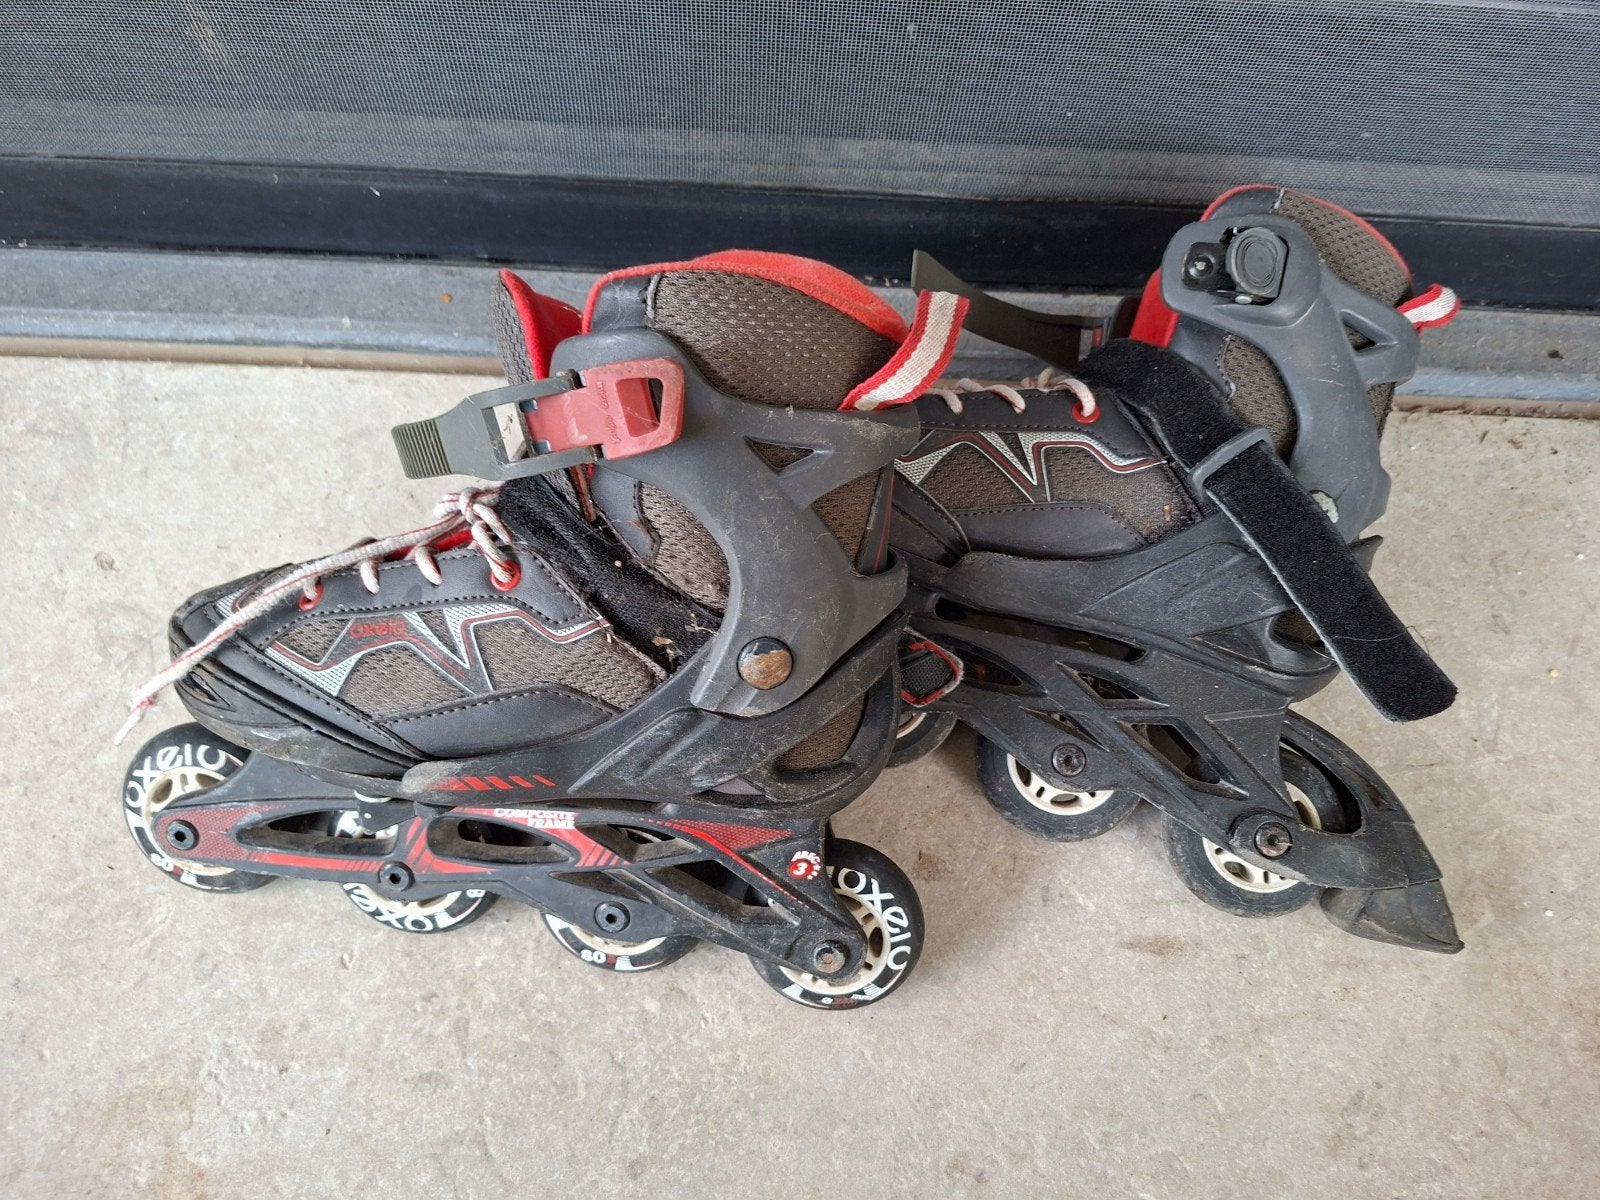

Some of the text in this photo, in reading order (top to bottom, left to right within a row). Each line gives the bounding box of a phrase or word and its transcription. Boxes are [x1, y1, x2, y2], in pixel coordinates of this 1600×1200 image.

[125, 744, 227, 808] oxelo
[494, 808, 575, 820] COMPOSITE
[528, 818, 575, 829] FRAME
[791, 851, 821, 864] ABEC
[793, 862, 808, 876] 3
[342, 882, 434, 931] oxel
[838, 867, 912, 971] oxelo
